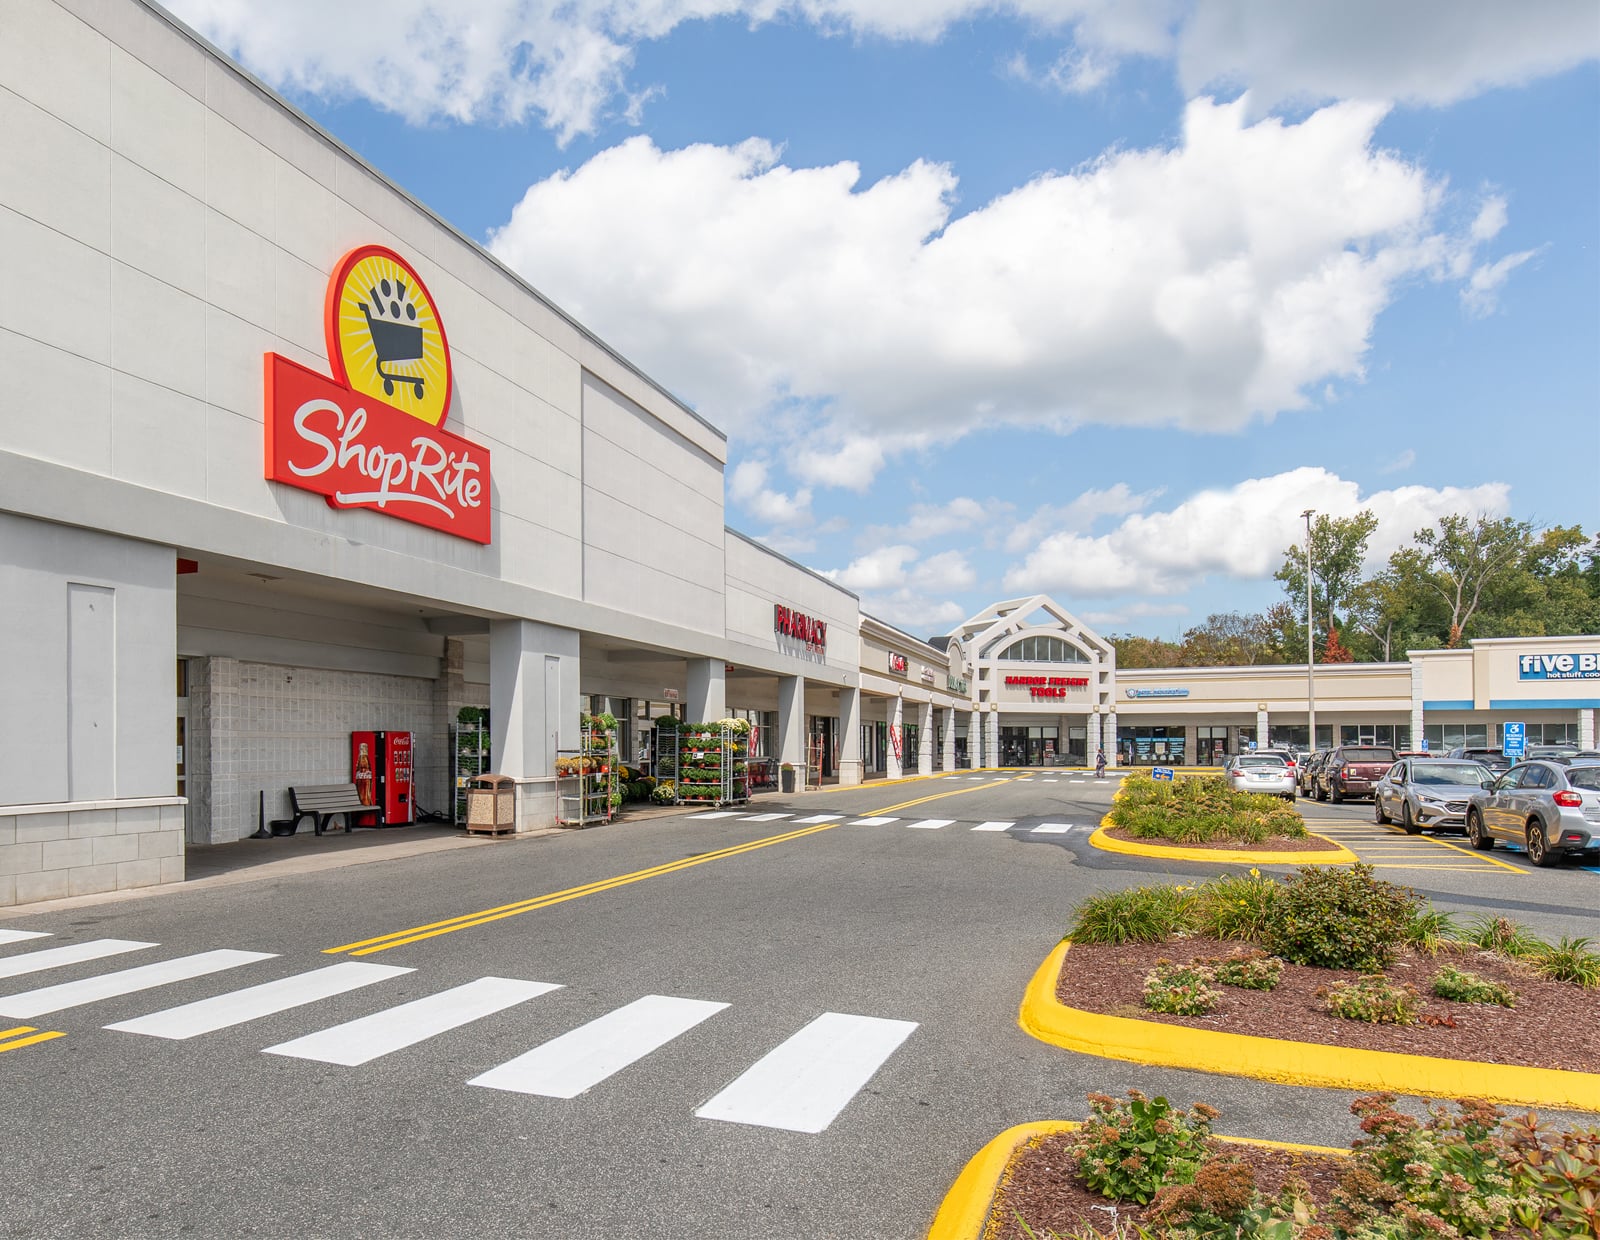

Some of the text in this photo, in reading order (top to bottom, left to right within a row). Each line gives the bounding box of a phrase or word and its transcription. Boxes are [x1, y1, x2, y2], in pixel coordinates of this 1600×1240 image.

[288, 399, 481, 508] ShopRite
[775, 604, 828, 646] PHARMACY
[1580, 654, 1600, 671] B
[1005, 676, 1089, 686] HARBOR FREIGHT
[1030, 687, 1066, 697] TOOLS
